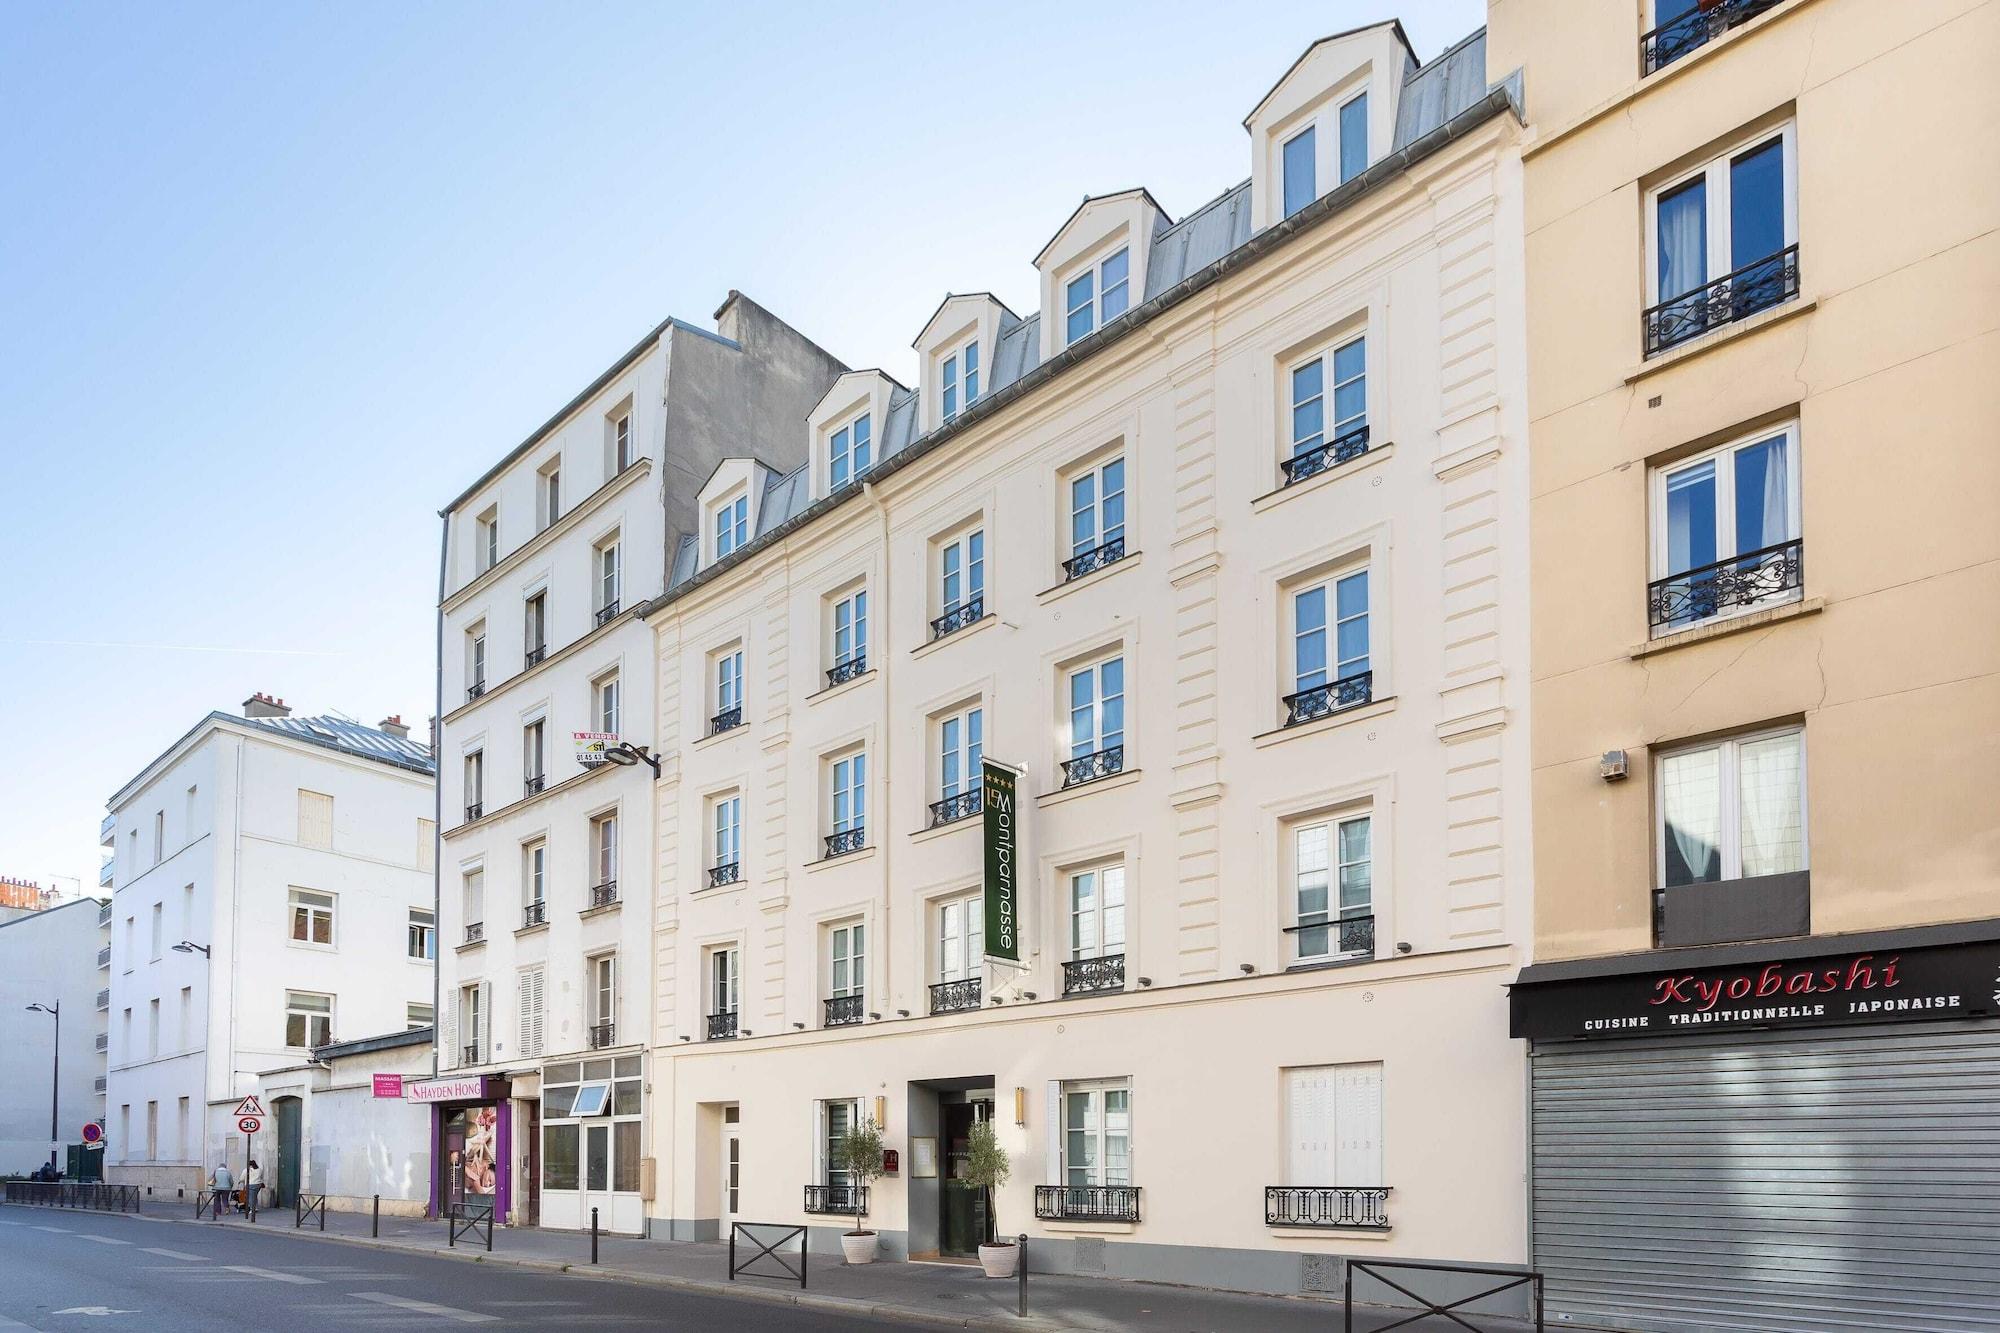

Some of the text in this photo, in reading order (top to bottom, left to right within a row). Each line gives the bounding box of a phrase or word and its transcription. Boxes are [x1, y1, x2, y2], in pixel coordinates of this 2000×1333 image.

[995, 791, 1014, 949] Montparnasse
[1650, 954, 1900, 1012] Kyobashi
[1584, 995, 1961, 1031] CUISINE TRADITIONNELLE JAPONAISE
[421, 1083, 481, 1099] HAYDEN HONG
[243, 1121, 257, 1129] 30
